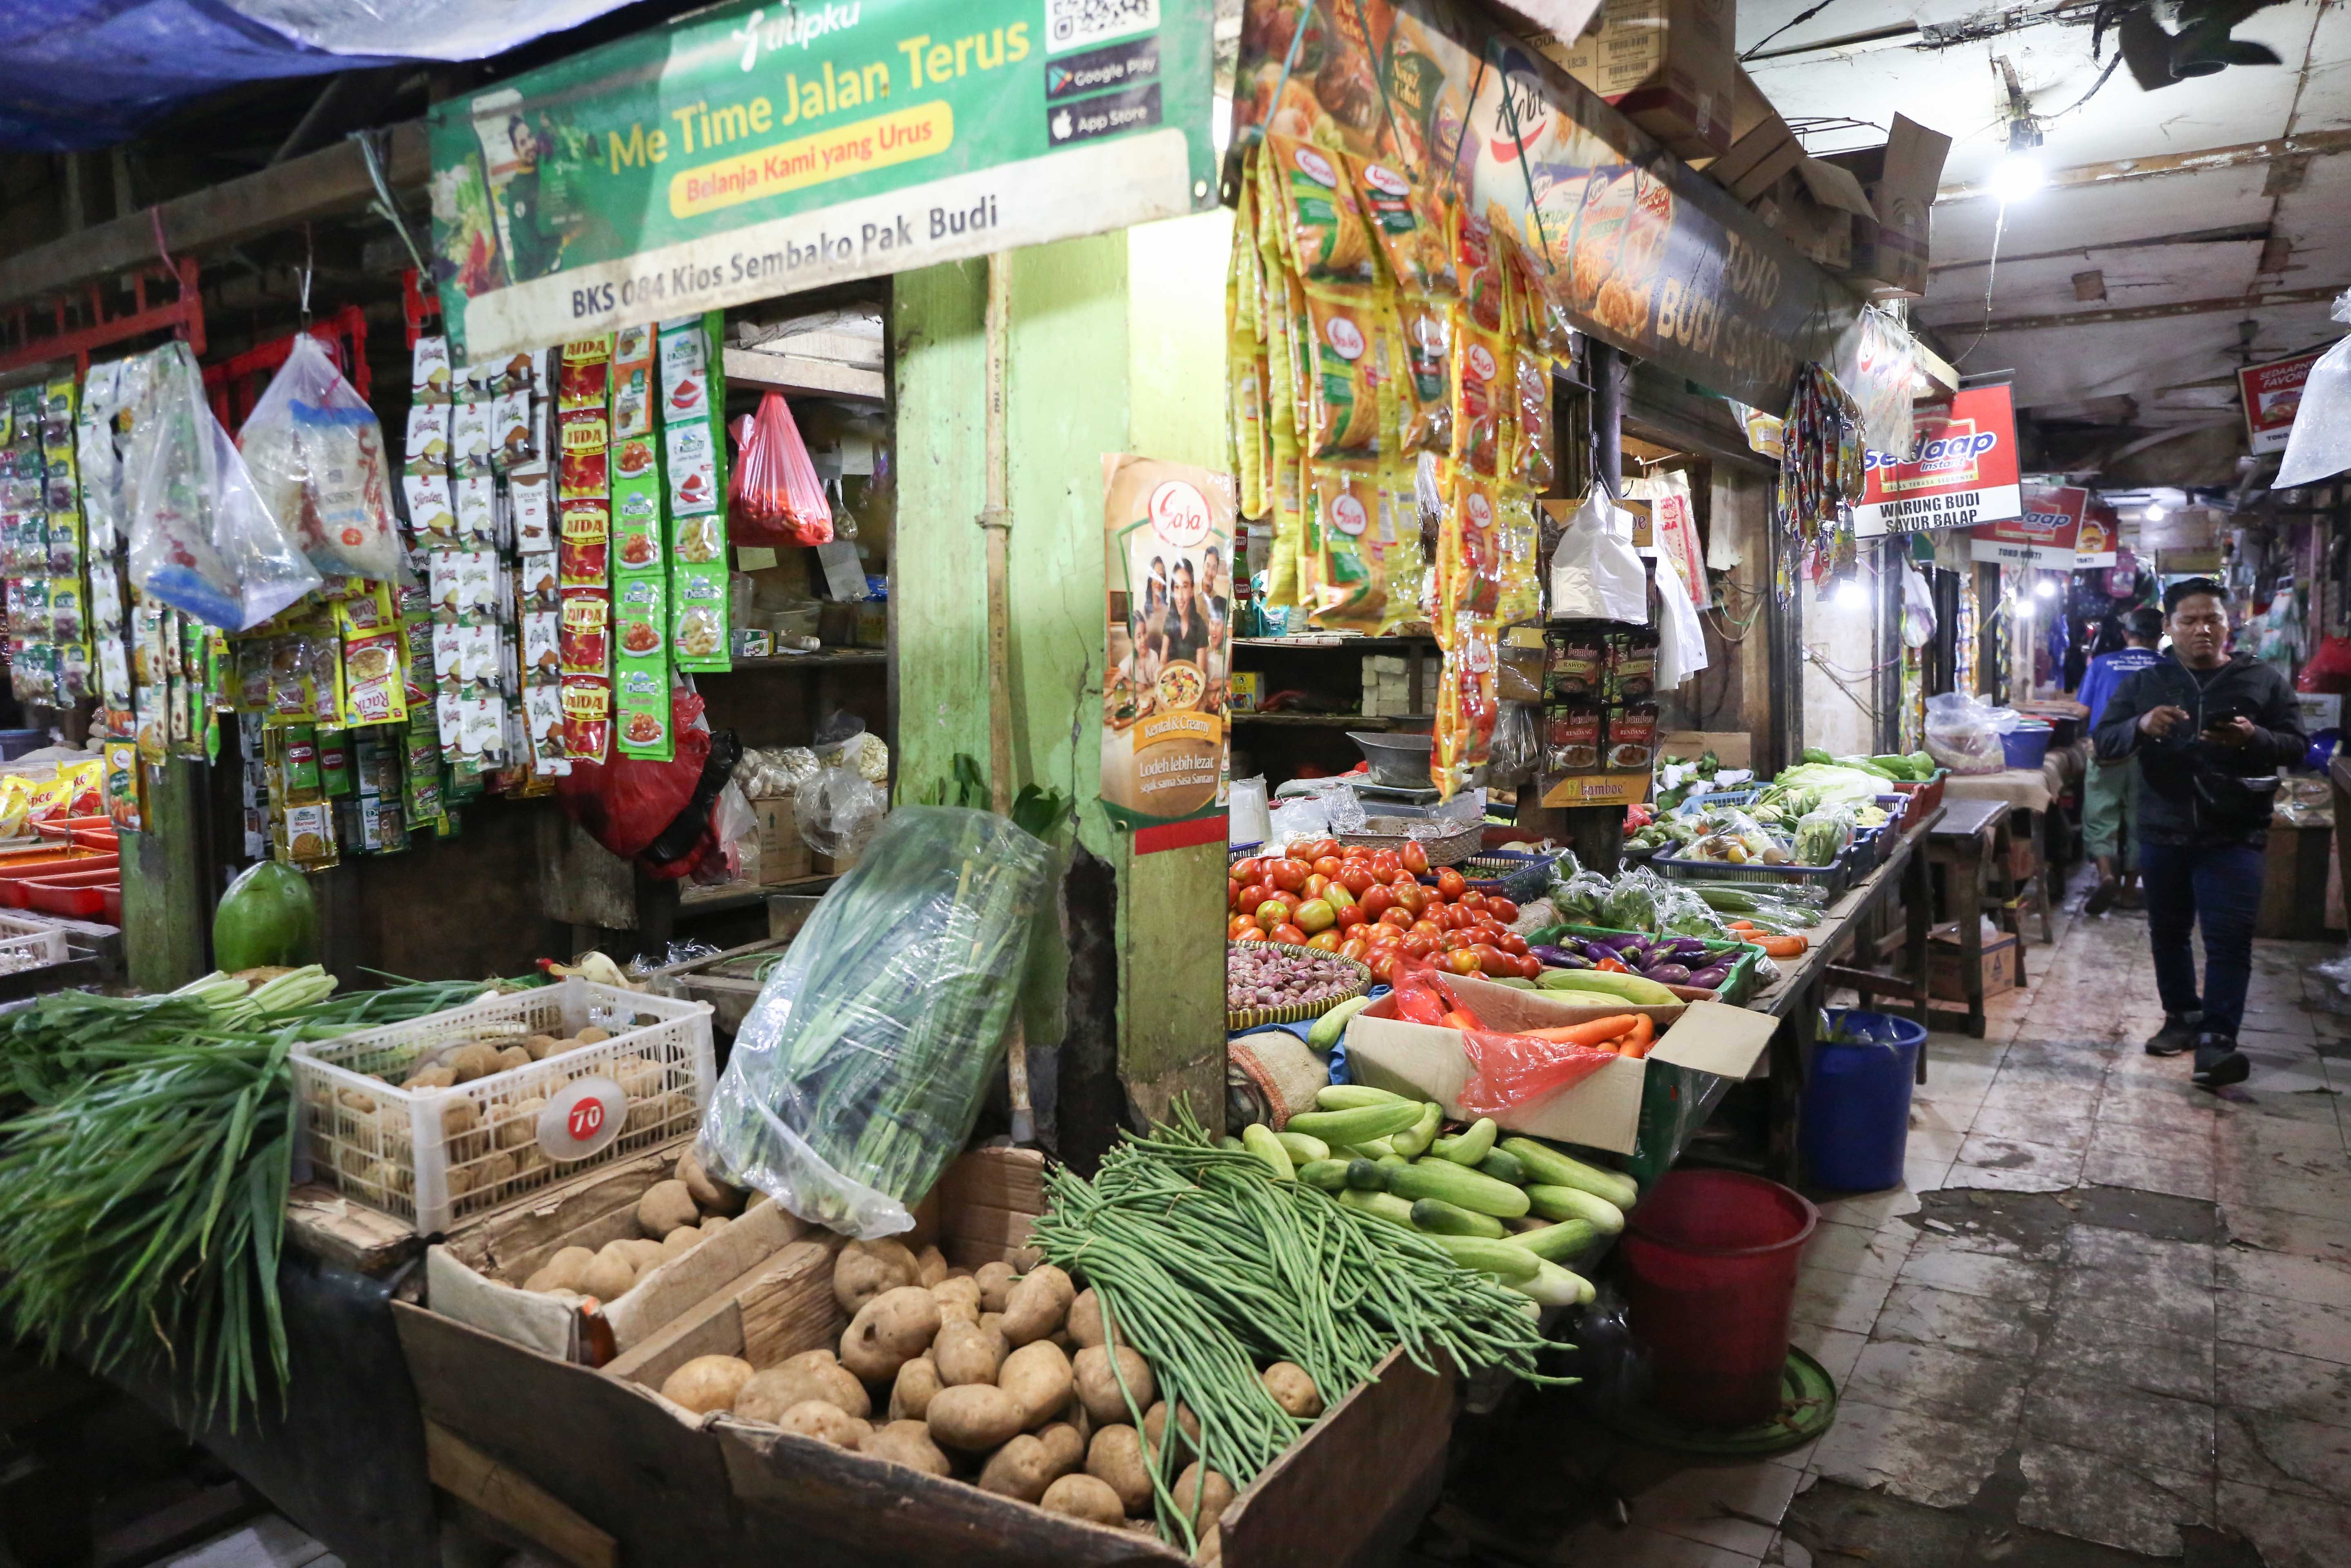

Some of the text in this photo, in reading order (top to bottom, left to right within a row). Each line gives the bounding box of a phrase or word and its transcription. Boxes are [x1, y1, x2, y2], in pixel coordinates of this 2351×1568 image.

[1073, 56, 1157, 88] Google Play
[608, 21, 1030, 175] Me Time Jalan Terus
[1496, 78, 1547, 138] Kobe
[1078, 105, 1148, 134] App Store
[686, 120, 932, 203] Belanja Kami yang Urus
[573, 195, 998, 319] BKS 084 Kios Sembako Pak Budi
[1722, 229, 1781, 310] TOKO
[1656, 277, 1726, 358] BUDI
[566, 340, 607, 356] AIDA
[2263, 371, 2308, 389] FAVORI
[1921, 457, 1965, 471] Instant
[1937, 474, 1974, 484] SEDAPNYA
[1159, 489, 1202, 530] Sasa
[1879, 492, 1980, 518] WARUNG BUDI
[1885, 509, 1977, 533] SAYUR BALAP
[354, 691, 390, 714] Racik
[566, 695, 603, 710] AIDA
[1144, 715, 1211, 739] Kental & Creamy
[1625, 709, 1655, 725] bamboe
[1139, 755, 1214, 778] Lodeh lebih lezat
[1176, 775, 1192, 786] Sasa
[1192, 774, 1214, 784] Santan
[1580, 778, 1623, 796] bamboe
[573, 1105, 601, 1133] 70
